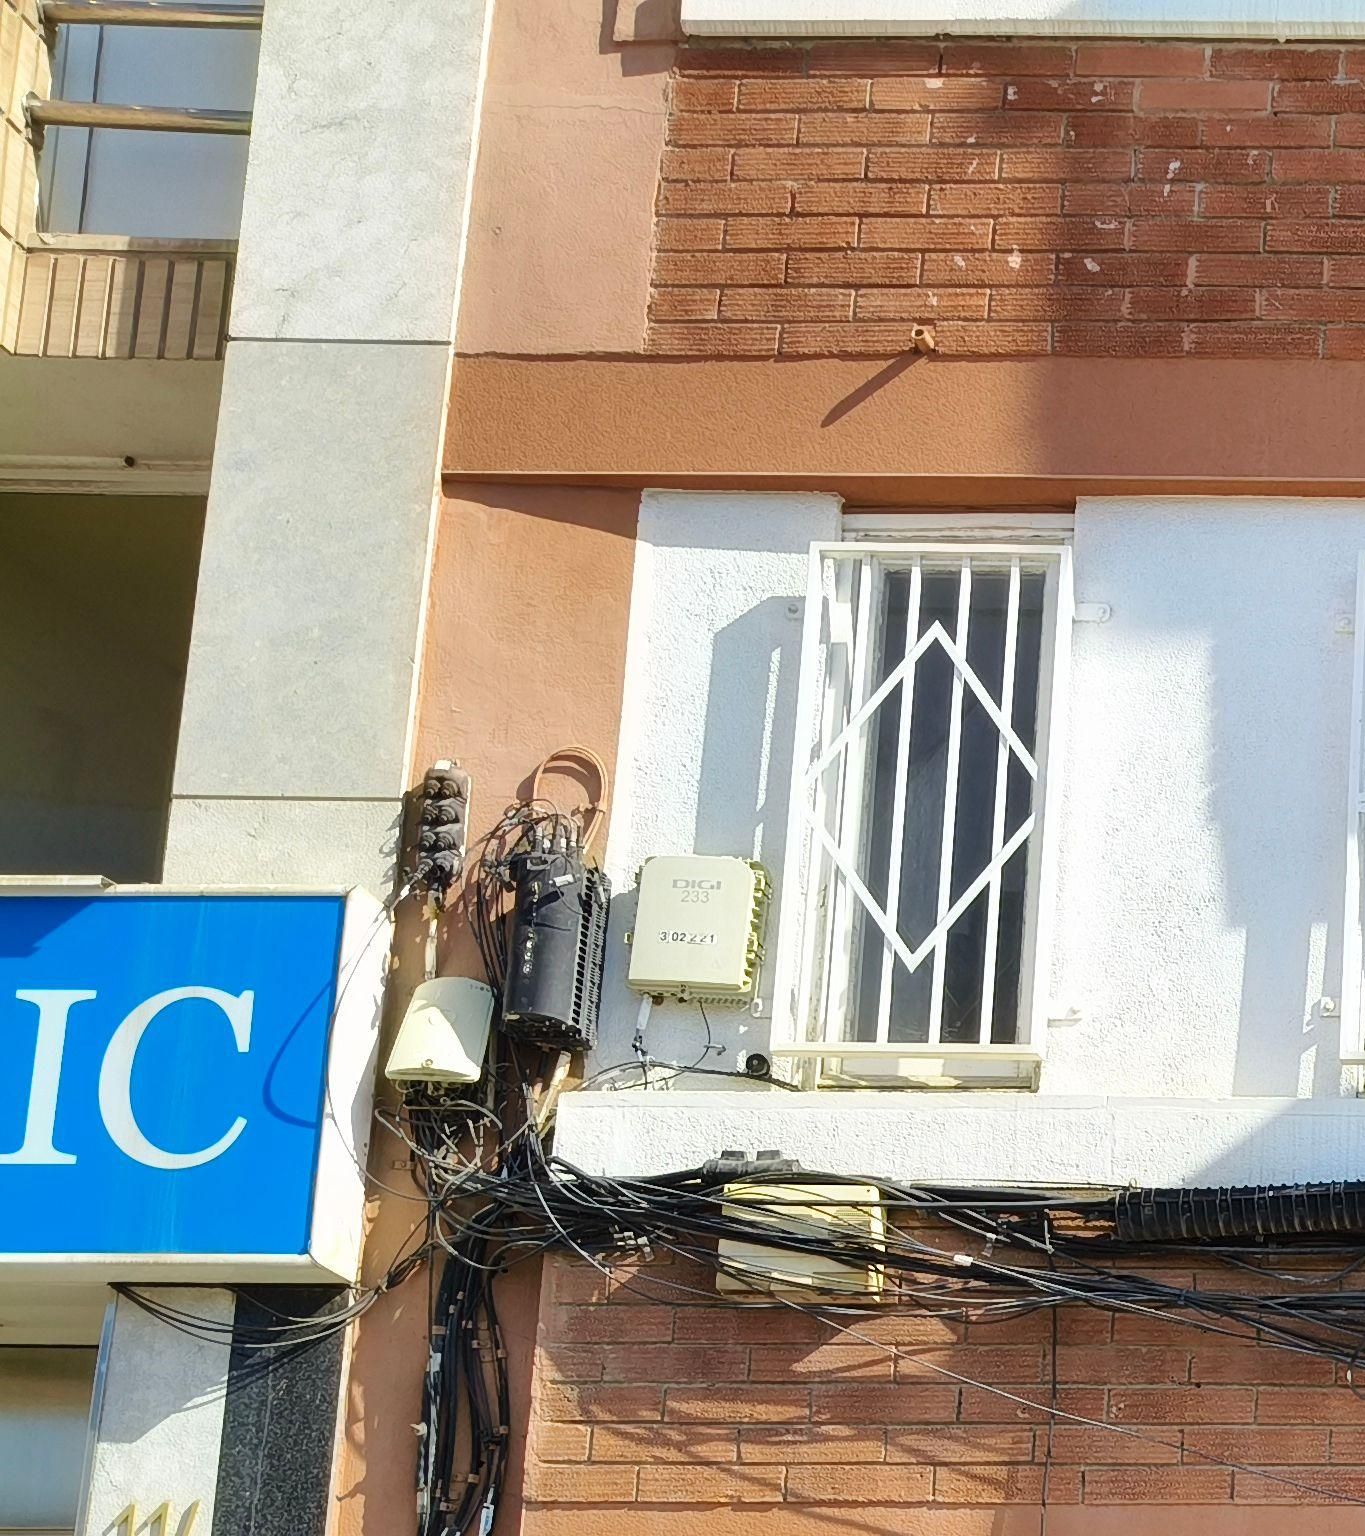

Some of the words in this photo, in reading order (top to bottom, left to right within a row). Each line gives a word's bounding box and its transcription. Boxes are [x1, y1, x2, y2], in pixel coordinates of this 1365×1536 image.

[672, 879, 722, 890] DIGI
[680, 890, 710, 903] 233
[0, 985, 255, 1171] IC
